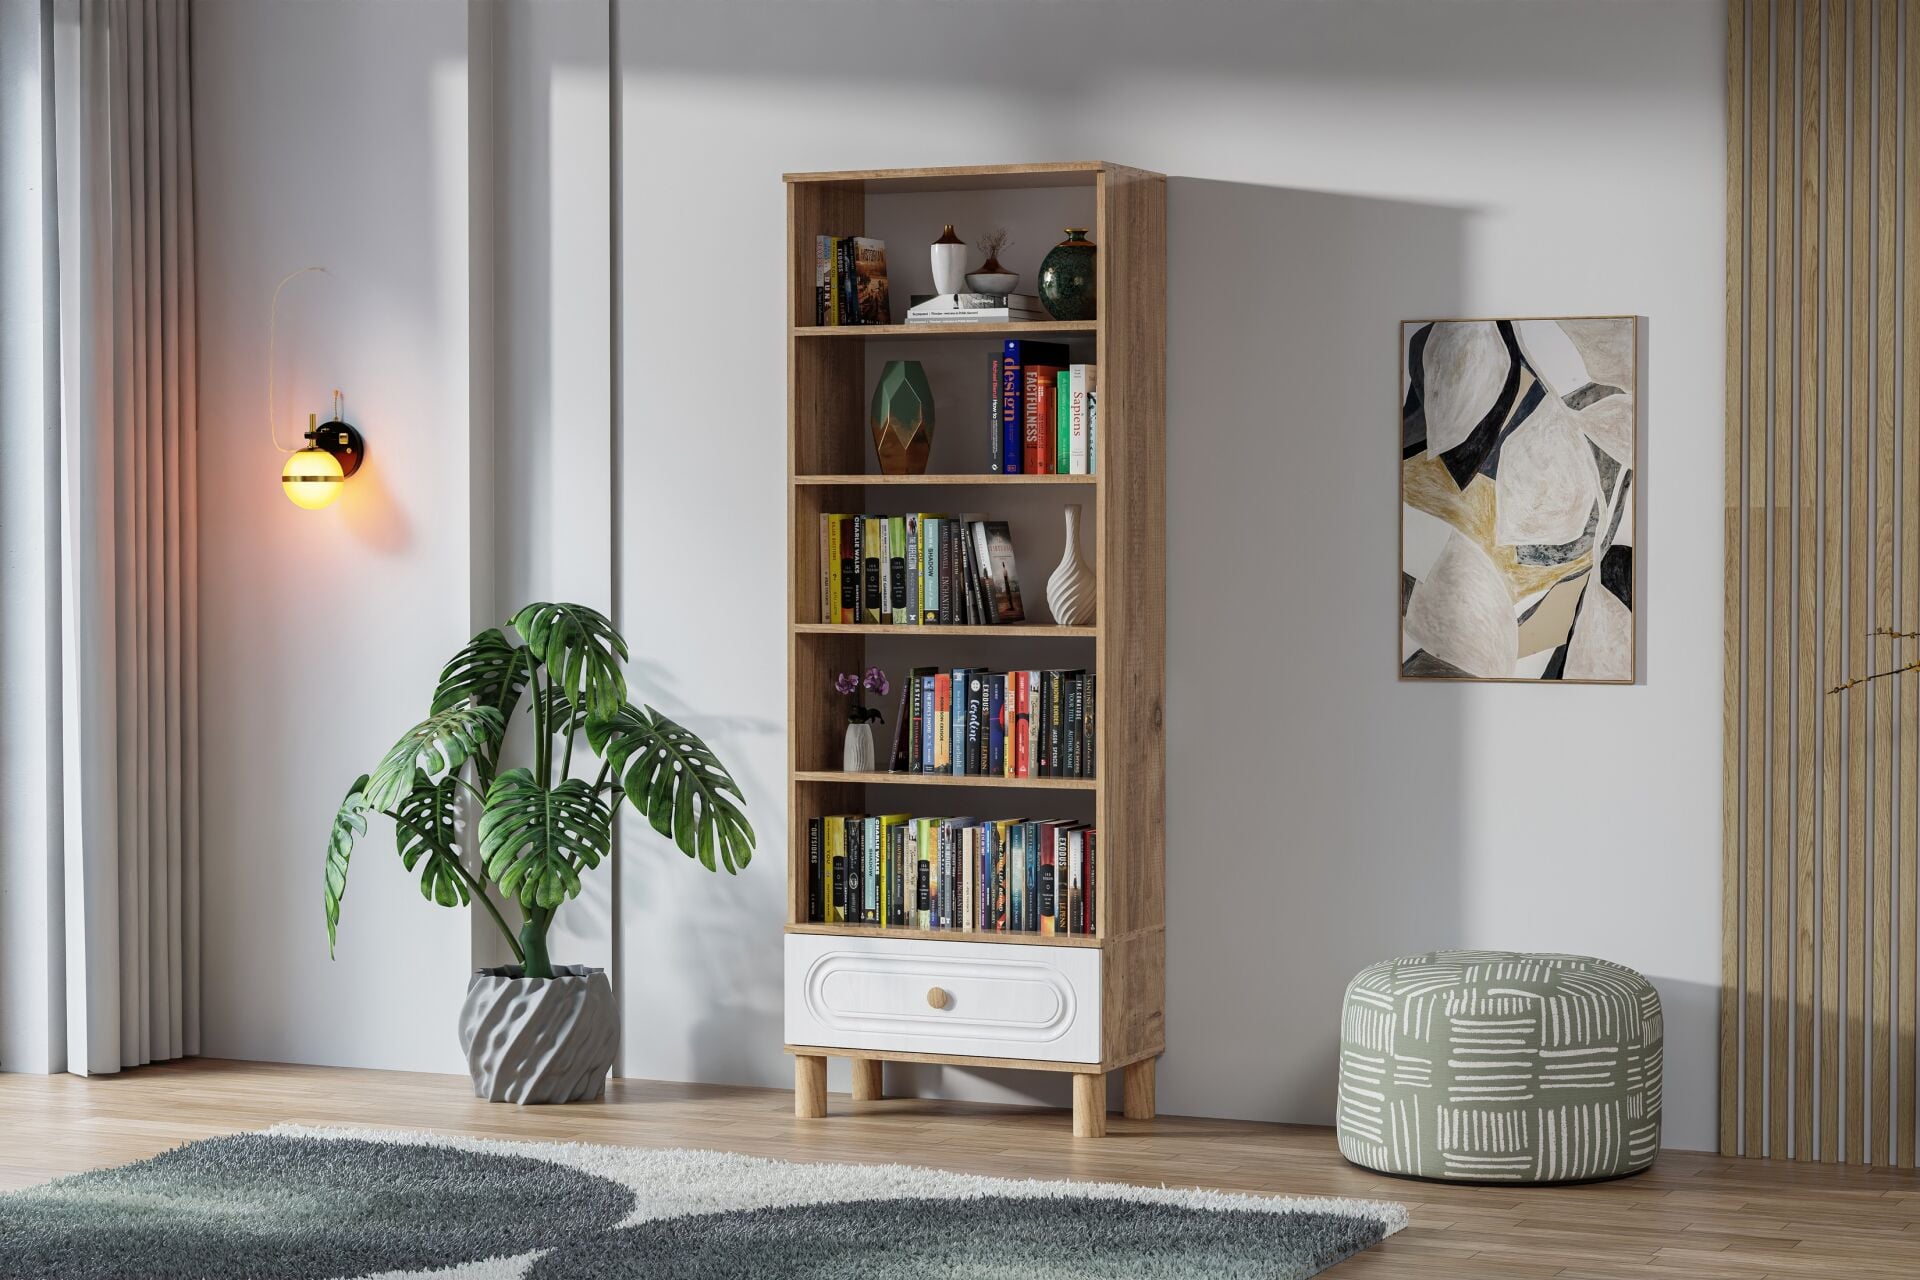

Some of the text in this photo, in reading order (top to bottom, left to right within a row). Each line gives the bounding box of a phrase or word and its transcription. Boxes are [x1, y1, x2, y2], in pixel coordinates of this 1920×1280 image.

[1004, 358, 1020, 422] design
[1026, 372, 1037, 442] FACTFULNESS
[1071, 391, 1084, 437] Sapiens
[942, 576, 950, 622] ENCHANTRESS
[969, 699, 980, 742] Coraline
[1059, 837, 1067, 866] EXODUS
